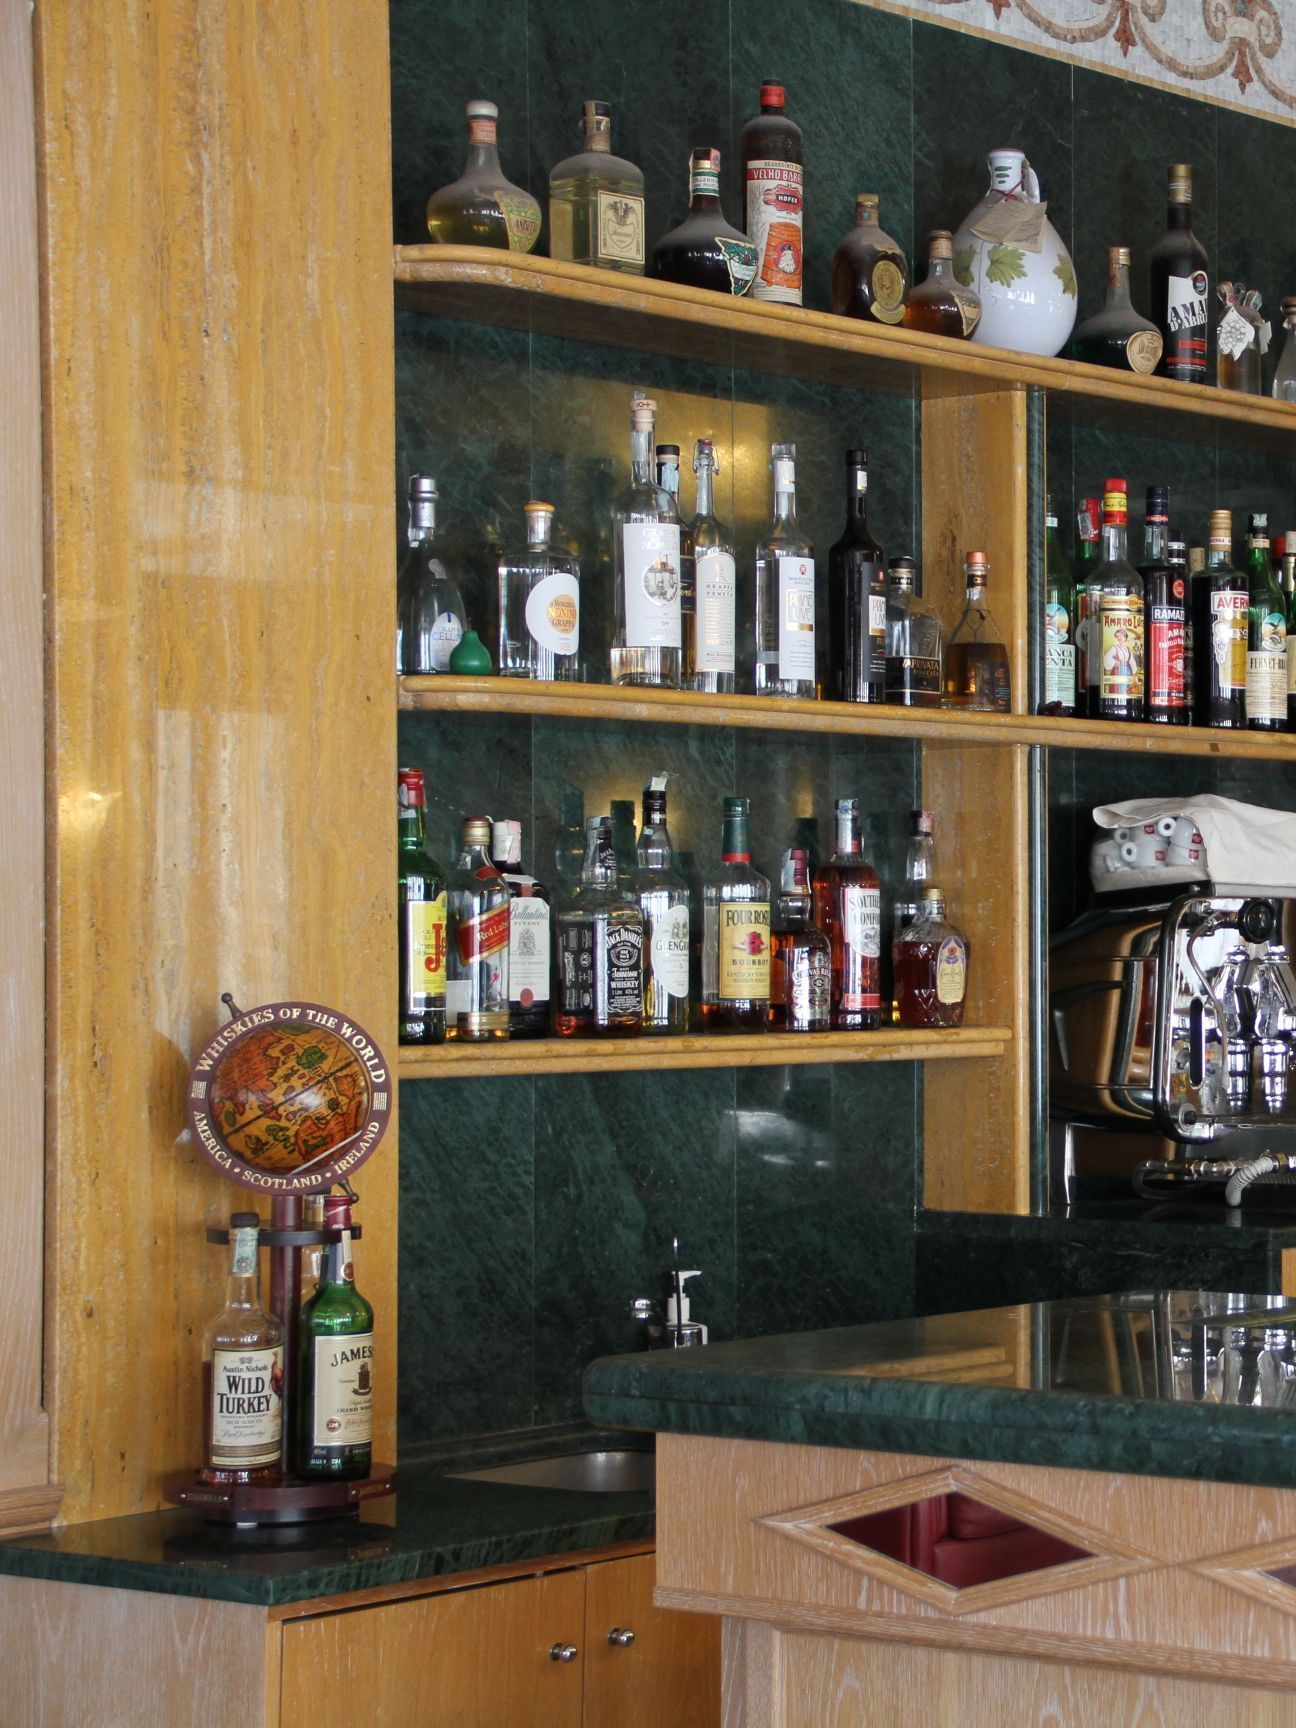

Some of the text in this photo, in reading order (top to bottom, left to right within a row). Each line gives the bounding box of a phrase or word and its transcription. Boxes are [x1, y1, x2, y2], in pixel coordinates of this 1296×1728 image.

[753, 169, 781, 180] VELHO
[726, 909, 752, 927] FOUR
[610, 980, 639, 988] WHISKEY
[194, 1008, 386, 1083] WHISKIES OF THE WORLD
[193, 1110, 380, 1190] AMERICA SCOTLAND IRELAND
[222, 1364, 268, 1373] Austin Nichols
[226, 1375, 266, 1395] WILD
[217, 1393, 272, 1415] TURKEY
